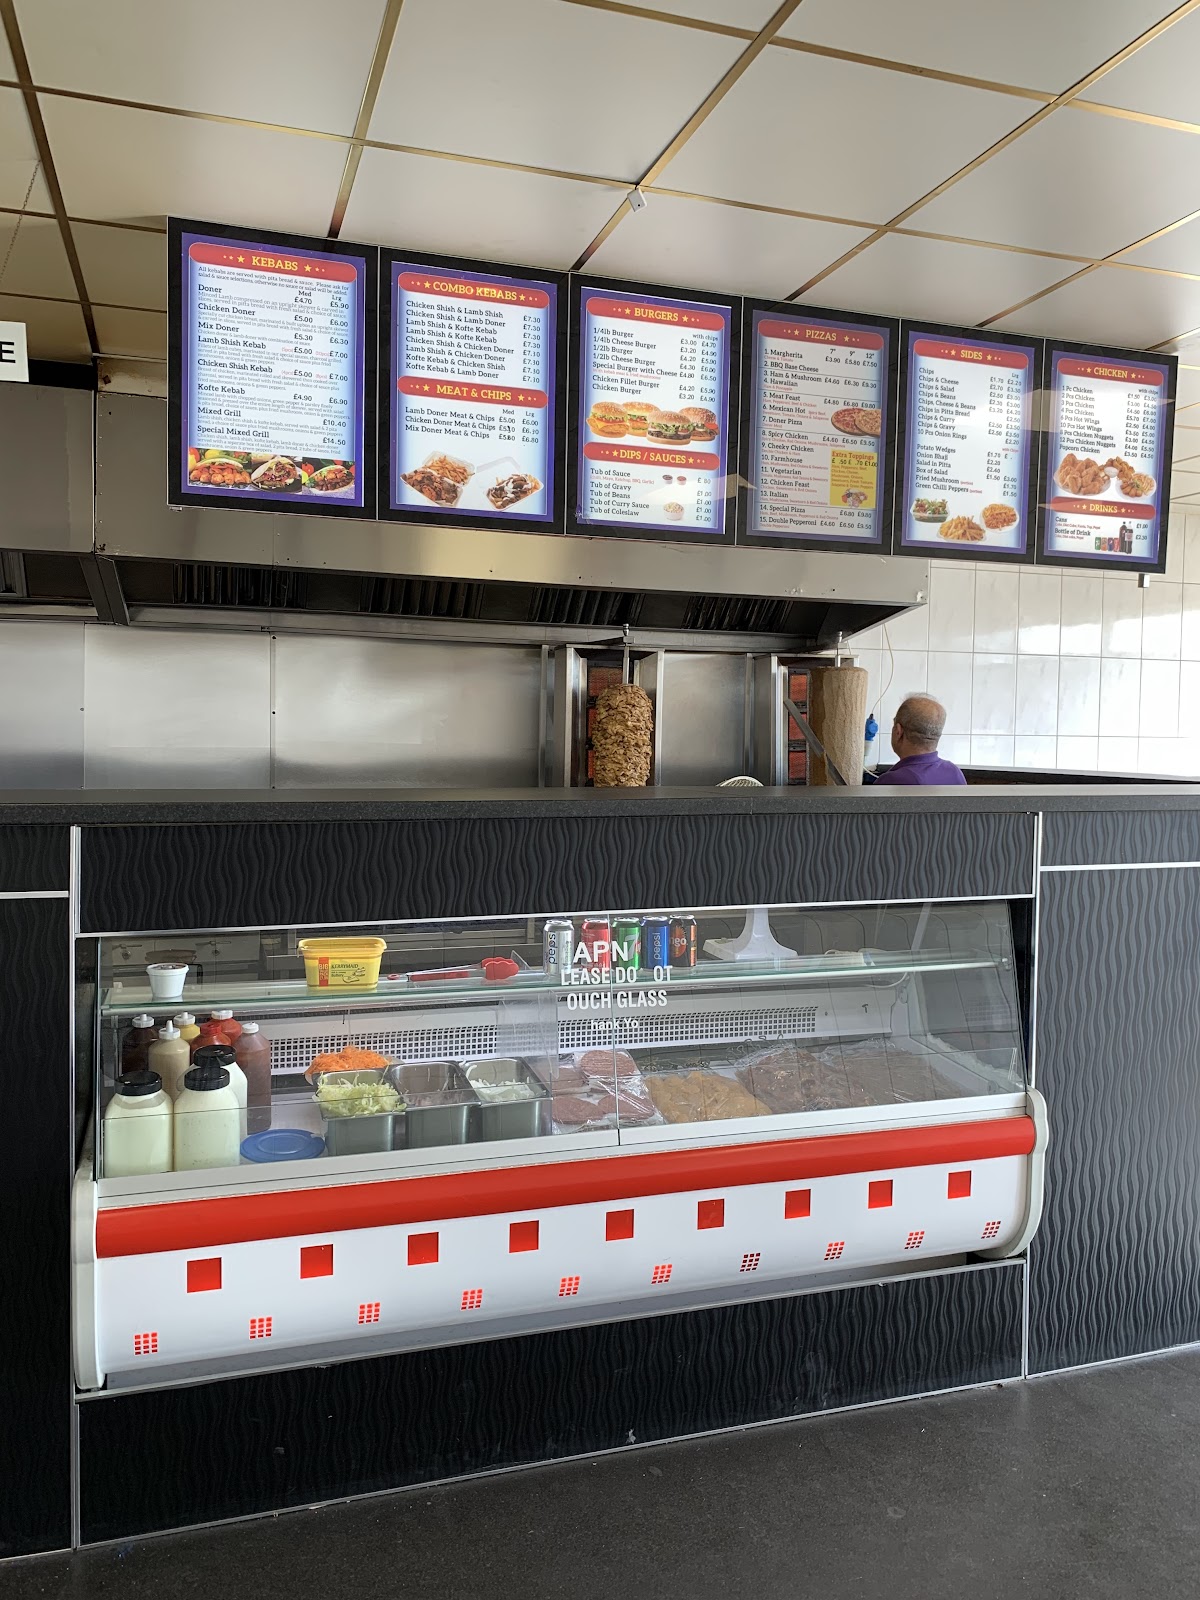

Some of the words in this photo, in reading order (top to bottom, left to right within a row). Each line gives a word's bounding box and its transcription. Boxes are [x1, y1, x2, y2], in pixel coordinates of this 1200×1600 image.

[252, 256, 298, 271] KEBABS
[198, 284, 222, 293] Doner
[294, 297, 312, 305] £4.70
[330, 301, 349, 309] £5.90
[433, 281, 473, 295] COMBO
[476, 287, 517, 301] KEBABS
[198, 302, 230, 313] Chicken
[232, 307, 256, 316] Doner
[294, 314, 313, 323] £5.00
[330, 319, 348, 328] £6.00
[406, 300, 435, 310] Chicken
[437, 304, 456, 313] Shish
[457, 306, 463, 314] &
[464, 307, 483, 316] Lamb
[485, 310, 503, 319] Shish
[523, 315, 540, 324] £7.30
[634, 307, 678, 322] BURGERS
[198, 321, 214, 329] Mix
[216, 323, 239, 333] Doner
[294, 333, 313, 341] £5.30
[330, 337, 349, 346] £6.30
[593, 327, 611, 336] 1/4lb
[612, 329, 634, 339] Burger
[805, 329, 837, 341] PIZZAS
[198, 336, 219, 344] Lamb
[221, 338, 241, 347] Shish
[243, 341, 266, 349] Kebab
[294, 347, 312, 355] £5.00
[329, 351, 348, 359] £7.00
[593, 344, 610, 353] 1/2lb
[611, 346, 633, 356] Burger
[770, 349, 803, 359] Margherita
[960, 350, 983, 360] SIDES
[198, 358, 227, 368] Chicken
[229, 362, 249, 371] Shish
[250, 364, 272, 373] Kebab
[293, 370, 312, 378] £5.00
[329, 374, 348, 382] £7.00
[406, 353, 425, 362] Kofte
[427, 356, 449, 365] Kebab
[451, 358, 456, 366] &
[457, 359, 485, 369] Chicken
[487, 363, 506, 372] Shish
[592, 361, 616, 371] Special
[617, 364, 638, 374] Burger
[640, 366, 655, 375] with
[656, 368, 677, 378] Cheese
[770, 361, 783, 369] BBQ
[785, 363, 799, 371] Base
[800, 365, 819, 374] Cheese
[919, 375, 934, 383] Chips
[940, 378, 959, 386] Cheese
[1094, 367, 1128, 379] CHICKEN
[198, 383, 220, 392] Kofte
[221, 386, 245, 395] Kebab
[293, 394, 312, 402] £4.90
[329, 397, 348, 406] £6.90
[436, 384, 468, 397] MEAT
[471, 388, 478, 398] &
[481, 389, 511, 401] CHIPS
[592, 383, 618, 393] Chicken
[619, 386, 641, 396] Burger
[198, 407, 222, 416] Mixed
[224, 409, 241, 418] Grill
[323, 419, 346, 428] £10.40
[405, 406, 425, 415] Lamb
[427, 409, 448, 418] Doner
[450, 411, 467, 420] Meat
[476, 414, 495, 422] Chips
[499, 416, 515, 425] £5.00
[522, 419, 538, 427] £6.00
[1084, 417, 1100, 425] Wings
[197, 425, 224, 434] Special
[226, 428, 251, 437] Mixed
[253, 430, 269, 439] Grill
[322, 437, 346, 446] £14.50
[832, 451, 845, 459] Extra
[846, 452, 874, 462] Toppings
[916, 444, 934, 452] Potato
[935, 446, 956, 454] Wedges
[620, 450, 641, 460] DIPS
[643, 452, 647, 461] /
[650, 453, 686, 465] SAUCES
[611, 469, 630, 477] Sauce
[915, 474, 930, 482] Fried
[931, 476, 960, 484] Mushroom
[770, 479, 795, 487] Chicken
[590, 506, 601, 514] Tub
[602, 507, 608, 515] of
[610, 508, 639, 517] Coleslaw
[769, 505, 790, 513] Special
[791, 506, 805, 514] Pizza
[1090, 503, 1118, 513] DRINKS
[653, 932, 663, 960] pepsi
[560, 966, 612, 986] LEASE
[615, 966, 637, 984] DO
[653, 965, 673, 982] OT
[566, 991, 612, 1011] OUCH
[616, 989, 669, 1009] GLASS
